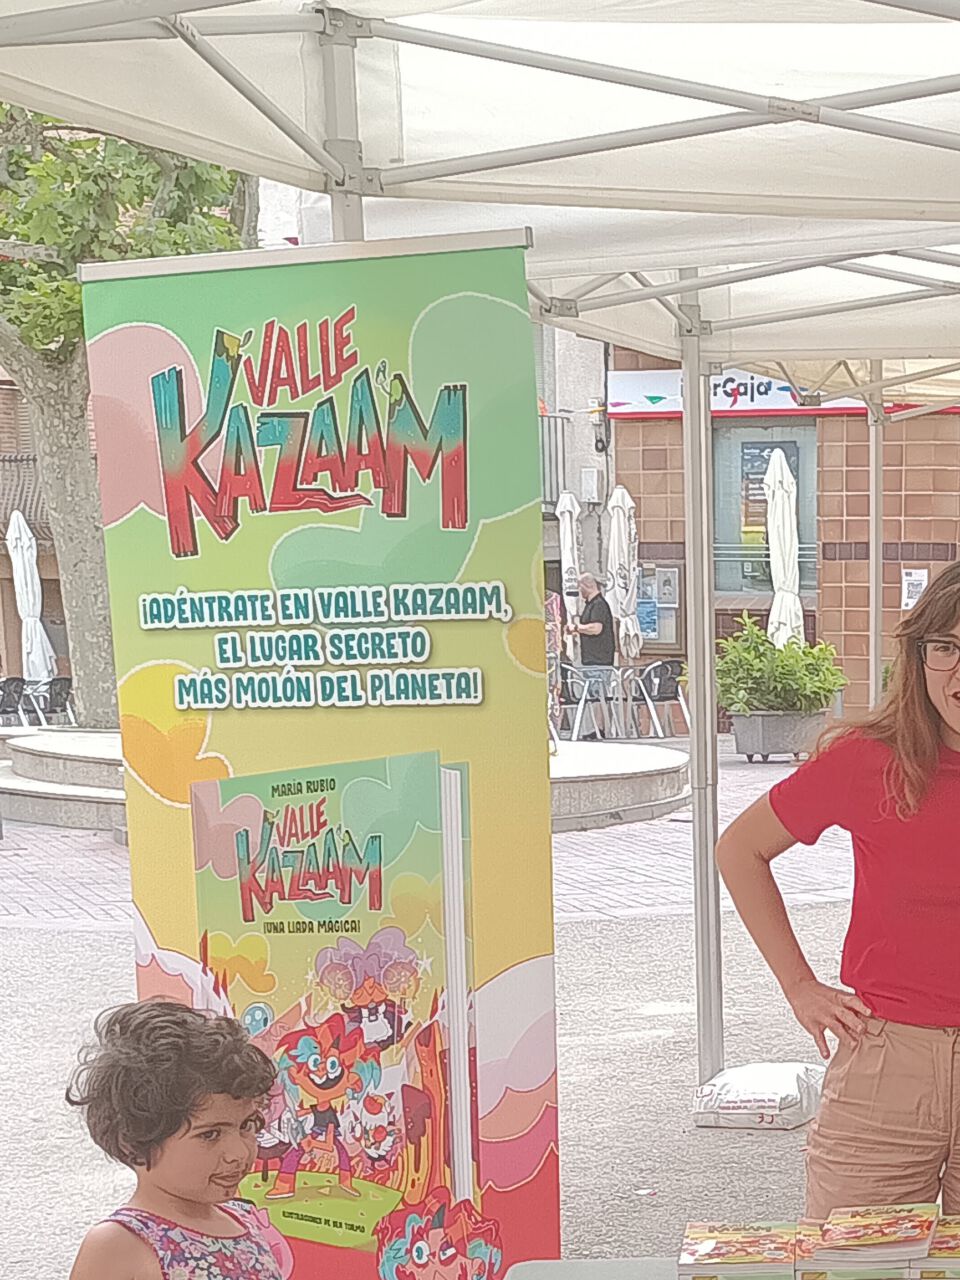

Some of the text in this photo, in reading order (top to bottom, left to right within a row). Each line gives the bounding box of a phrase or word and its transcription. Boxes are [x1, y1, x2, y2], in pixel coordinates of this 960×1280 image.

[245, 305, 359, 406] VALLE
[150, 326, 468, 559] KAZAAM
[142, 586, 511, 625] ¡ADÉNTRATE EN VALLE KAZAAM,
[218, 630, 426, 664] EL LUGAR SECRETO
[177, 667, 479, 705] MÁS MOLÓN DEL PLANETA!
[306, 778, 336, 793] RUBIO
[276, 797, 328, 847] VALLE
[237, 810, 379, 922] KAZAAM
[288, 920, 314, 934] LIADA
